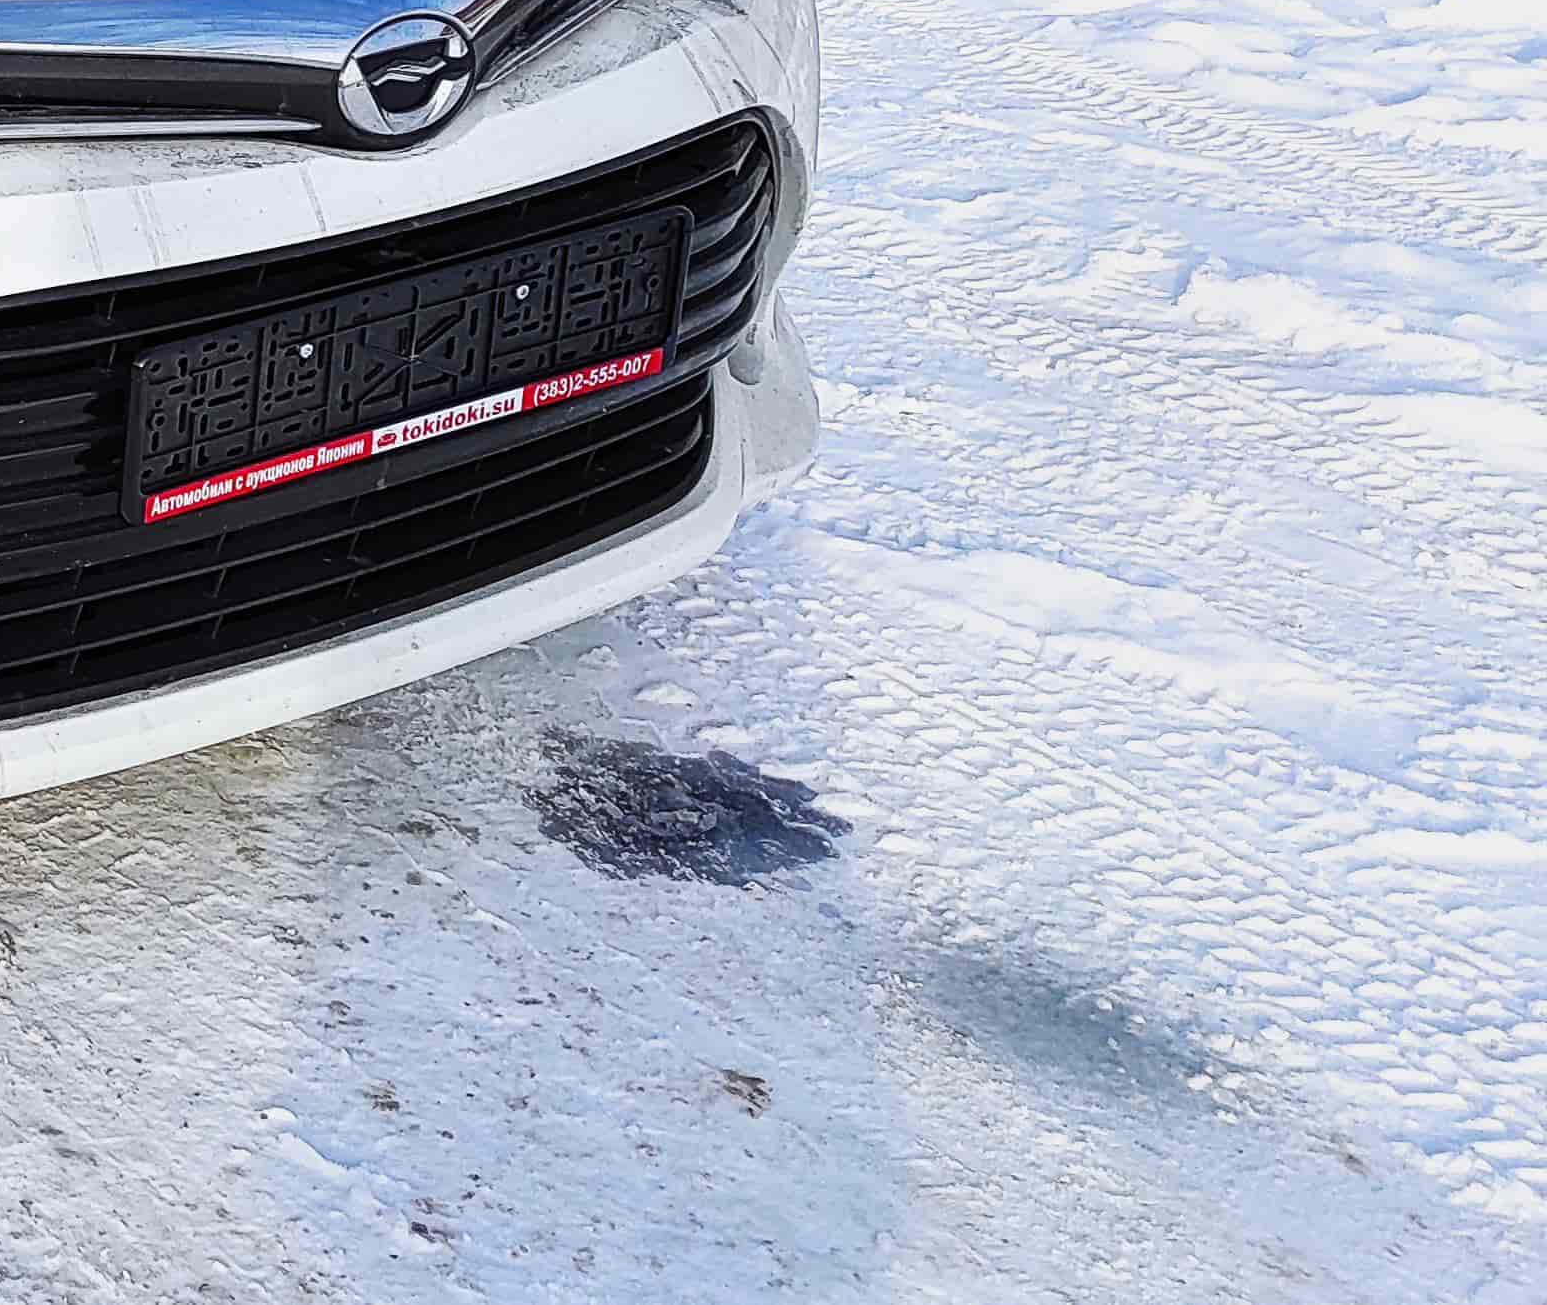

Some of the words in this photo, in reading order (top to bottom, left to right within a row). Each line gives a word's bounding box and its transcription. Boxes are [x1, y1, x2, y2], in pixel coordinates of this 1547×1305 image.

[533, 353, 652, 408] (383)2-555-007
[402, 394, 516, 442] tokidoki.su
[150, 480, 233, 517] Автомобили
[235, 476, 244, 490] с
[245, 454, 315, 489] аукционов
[316, 439, 365, 466] Японии
